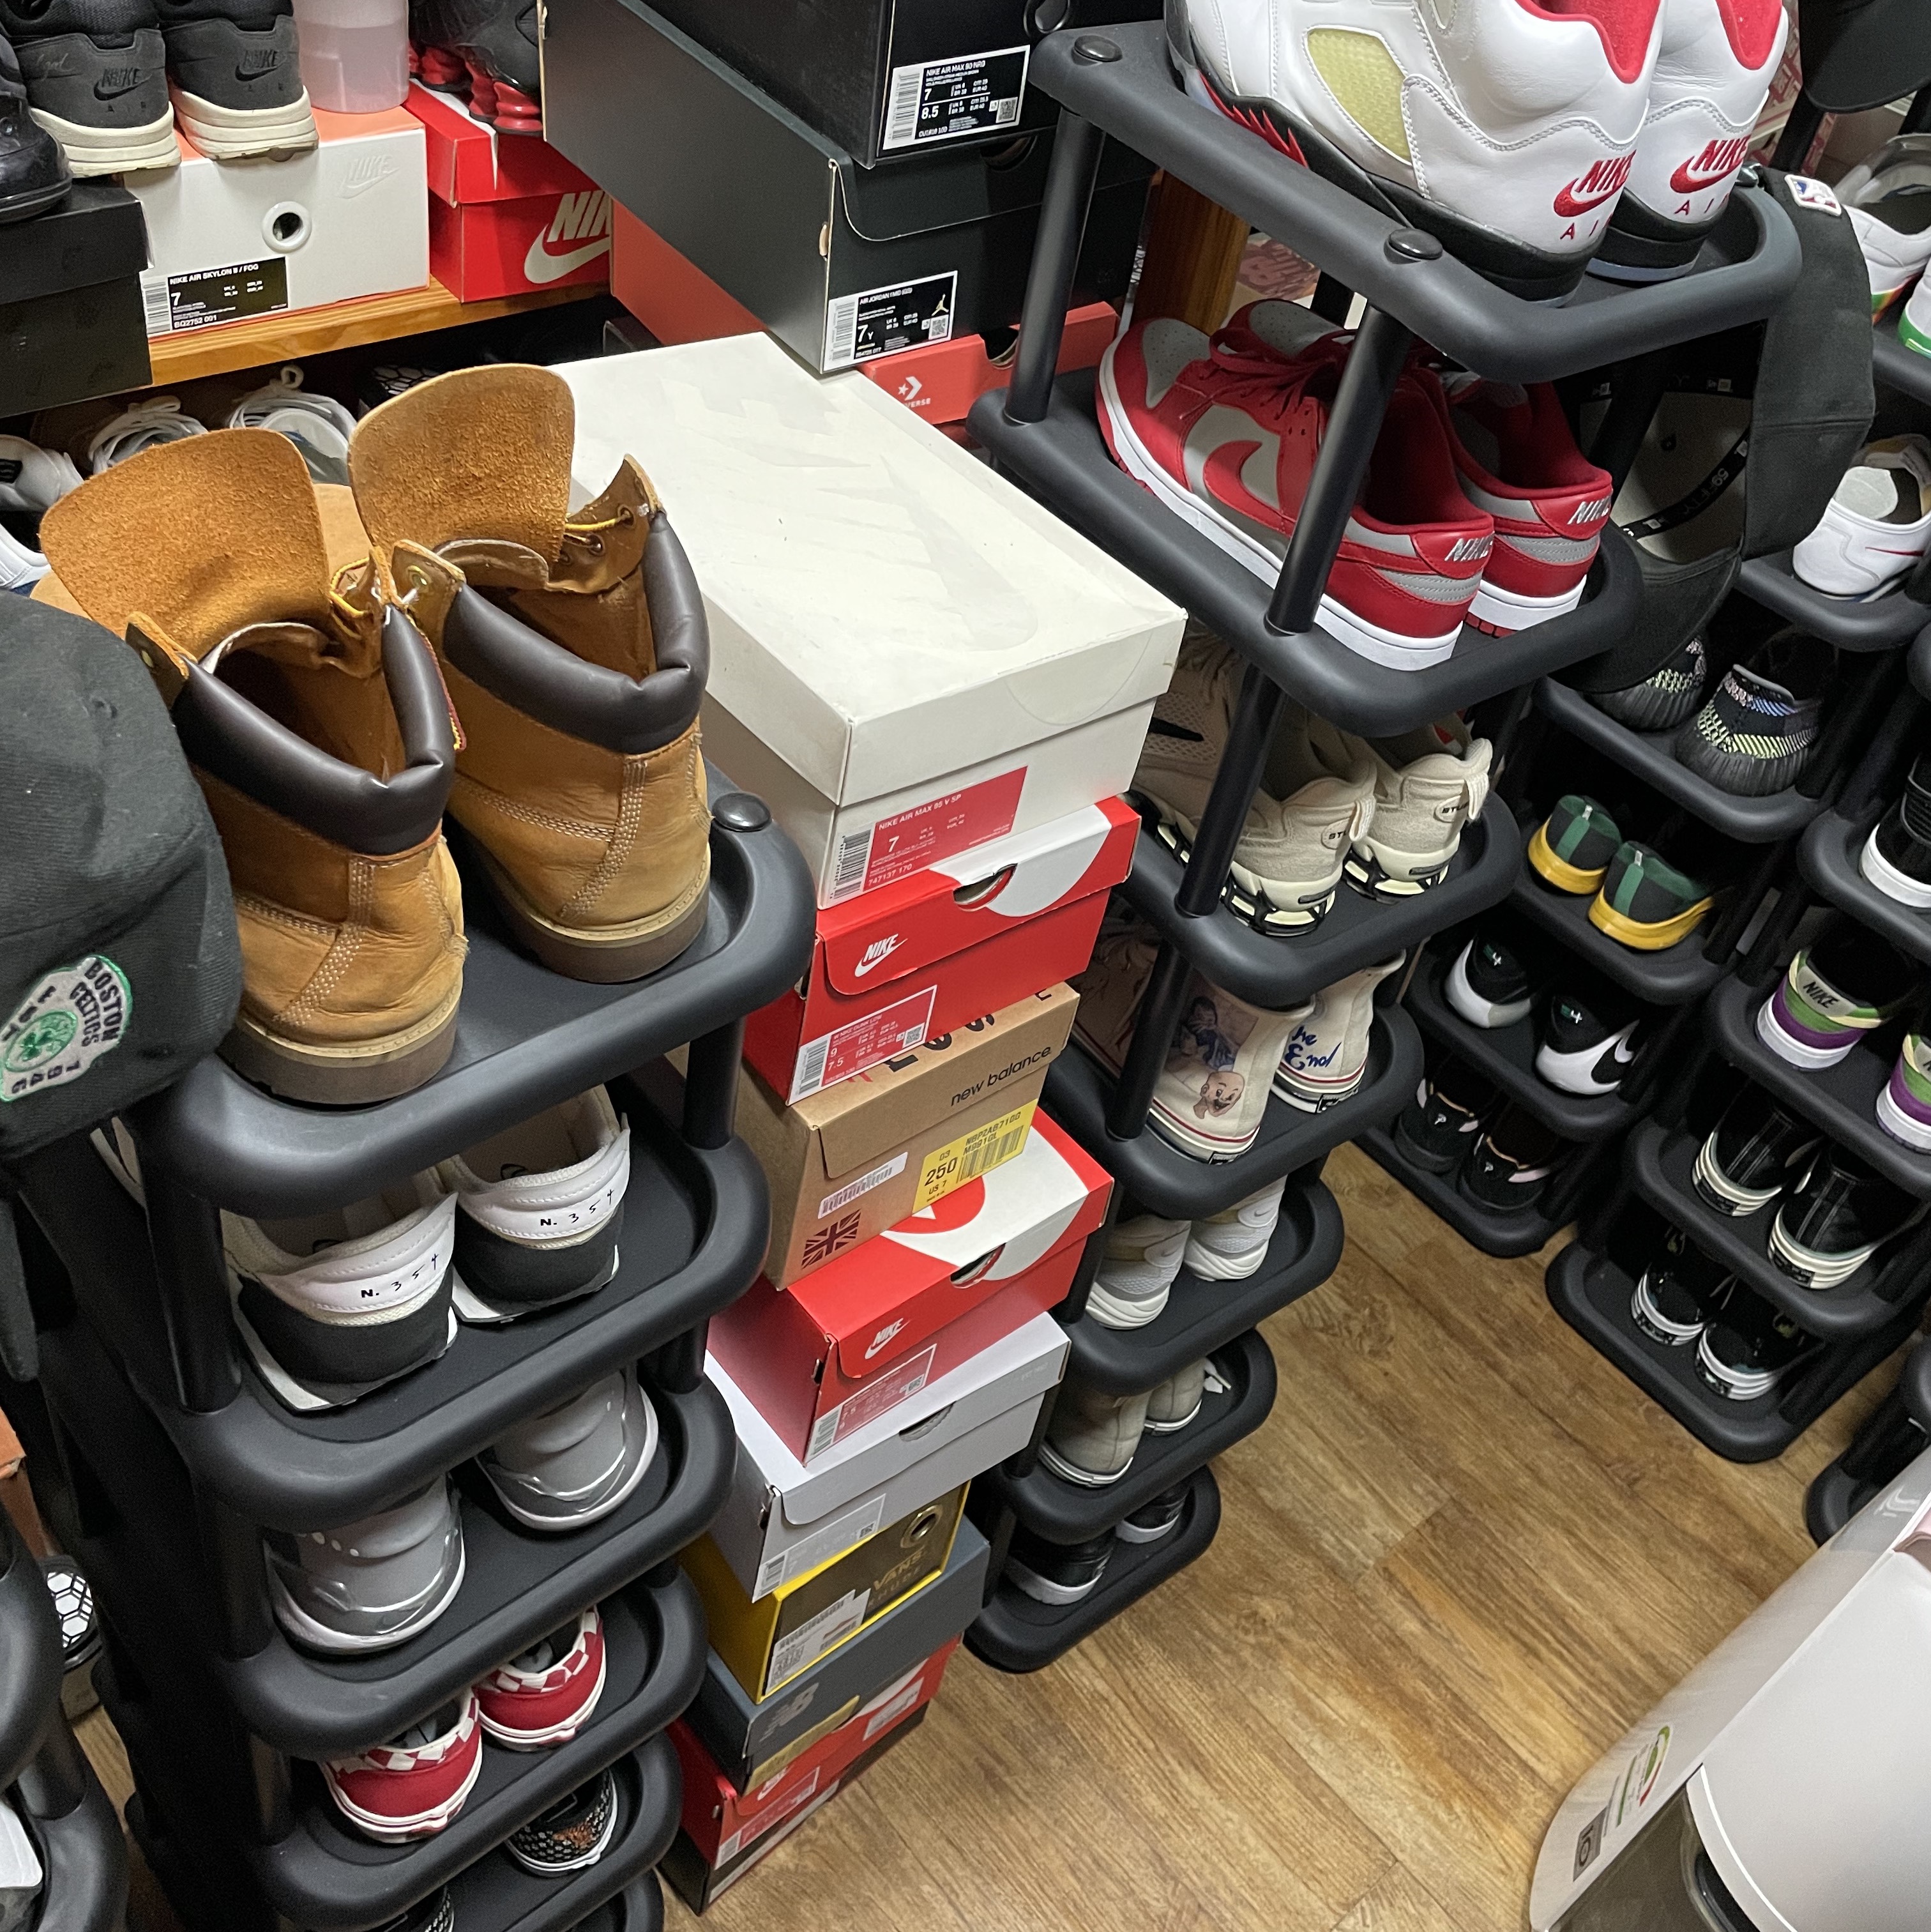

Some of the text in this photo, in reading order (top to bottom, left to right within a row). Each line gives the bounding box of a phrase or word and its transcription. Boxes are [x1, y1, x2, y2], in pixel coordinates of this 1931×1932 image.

[927, 68, 941, 77] NIKE
[941, 66, 951, 74] AIR
[951, 63, 966, 72] MAX
[925, 88, 932, 100] 7
[921, 105, 939, 119] 8.5
[547, 190, 611, 243] NIK
[169, 277, 188, 285] NIKE
[189, 273, 202, 282] AIR
[202, 269, 232, 279] SKYLON
[243, 263, 259, 272] FOG
[171, 292, 181, 306] 7
[904, 398, 931, 408] VERSE
[879, 817, 898, 831] NIKE
[899, 812, 913, 823] AIR
[914, 804, 933, 817] MAX
[951, 794, 962, 803] SP
[888, 835, 900, 853] 7
[868, 863, 912, 886] 747137 170
[863, 934, 899, 963] NIKE
[84, 960, 123, 1042] BOSTON
[1803, 981, 1840, 1009] NIKE
[69, 982, 102, 1047] CELTICS
[1291, 1024, 1318, 1046] he
[830, 1047, 838, 1058] 9
[1284, 1041, 1342, 1071] End
[828, 1057, 844, 1072] 7.5
[11, 1058, 80, 1094] 1946
[951, 1046, 1052, 1107] new balance
[939, 1150, 951, 1162] 03
[924, 1157, 958, 1187] 250
[928, 1183, 940, 1195] US
[540, 1218, 557, 1226] N.
[361, 1289, 379, 1298] N.
[872, 1318, 904, 1348] NIKE
